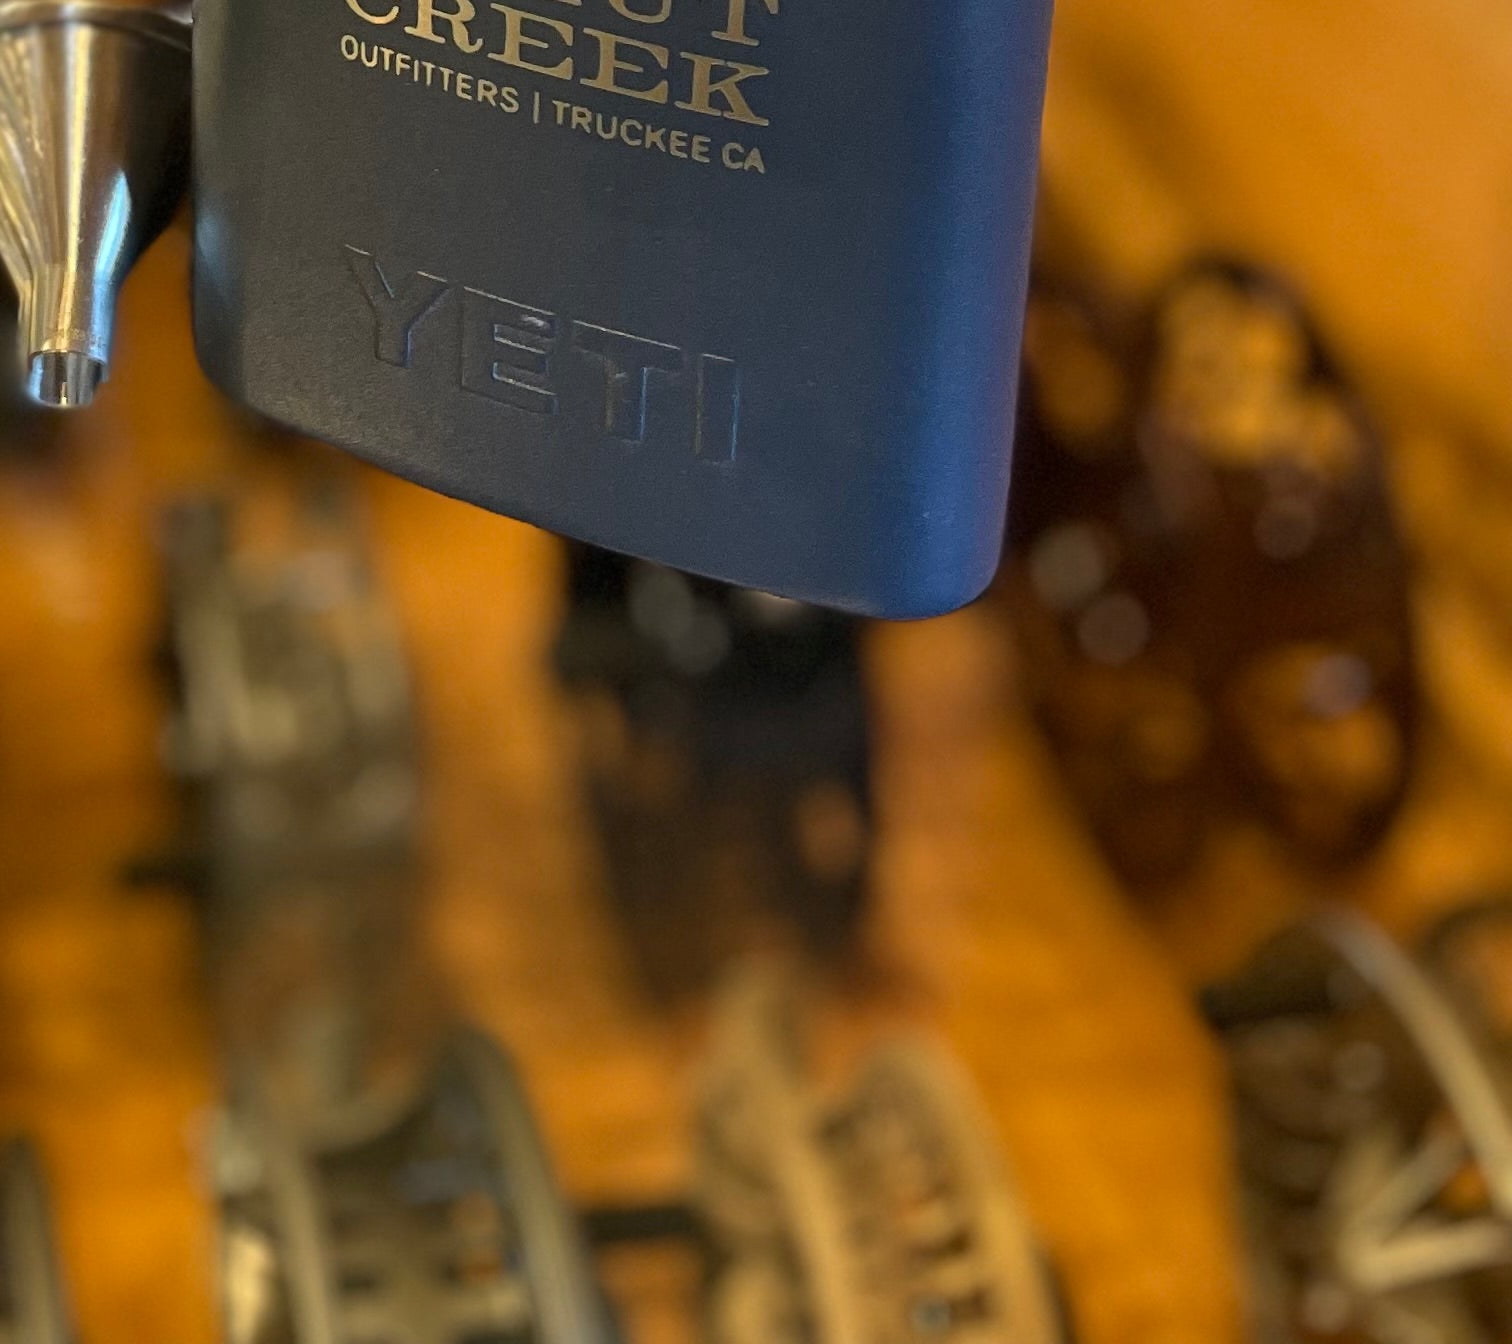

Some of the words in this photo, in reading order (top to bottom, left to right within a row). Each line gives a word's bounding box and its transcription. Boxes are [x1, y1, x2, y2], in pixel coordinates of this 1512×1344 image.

[340, 35, 520, 113] OUTFITTERS
[552, 99, 711, 164] TRUCKEE
[721, 141, 766, 174] CA
[345, 243, 741, 468] YETI
